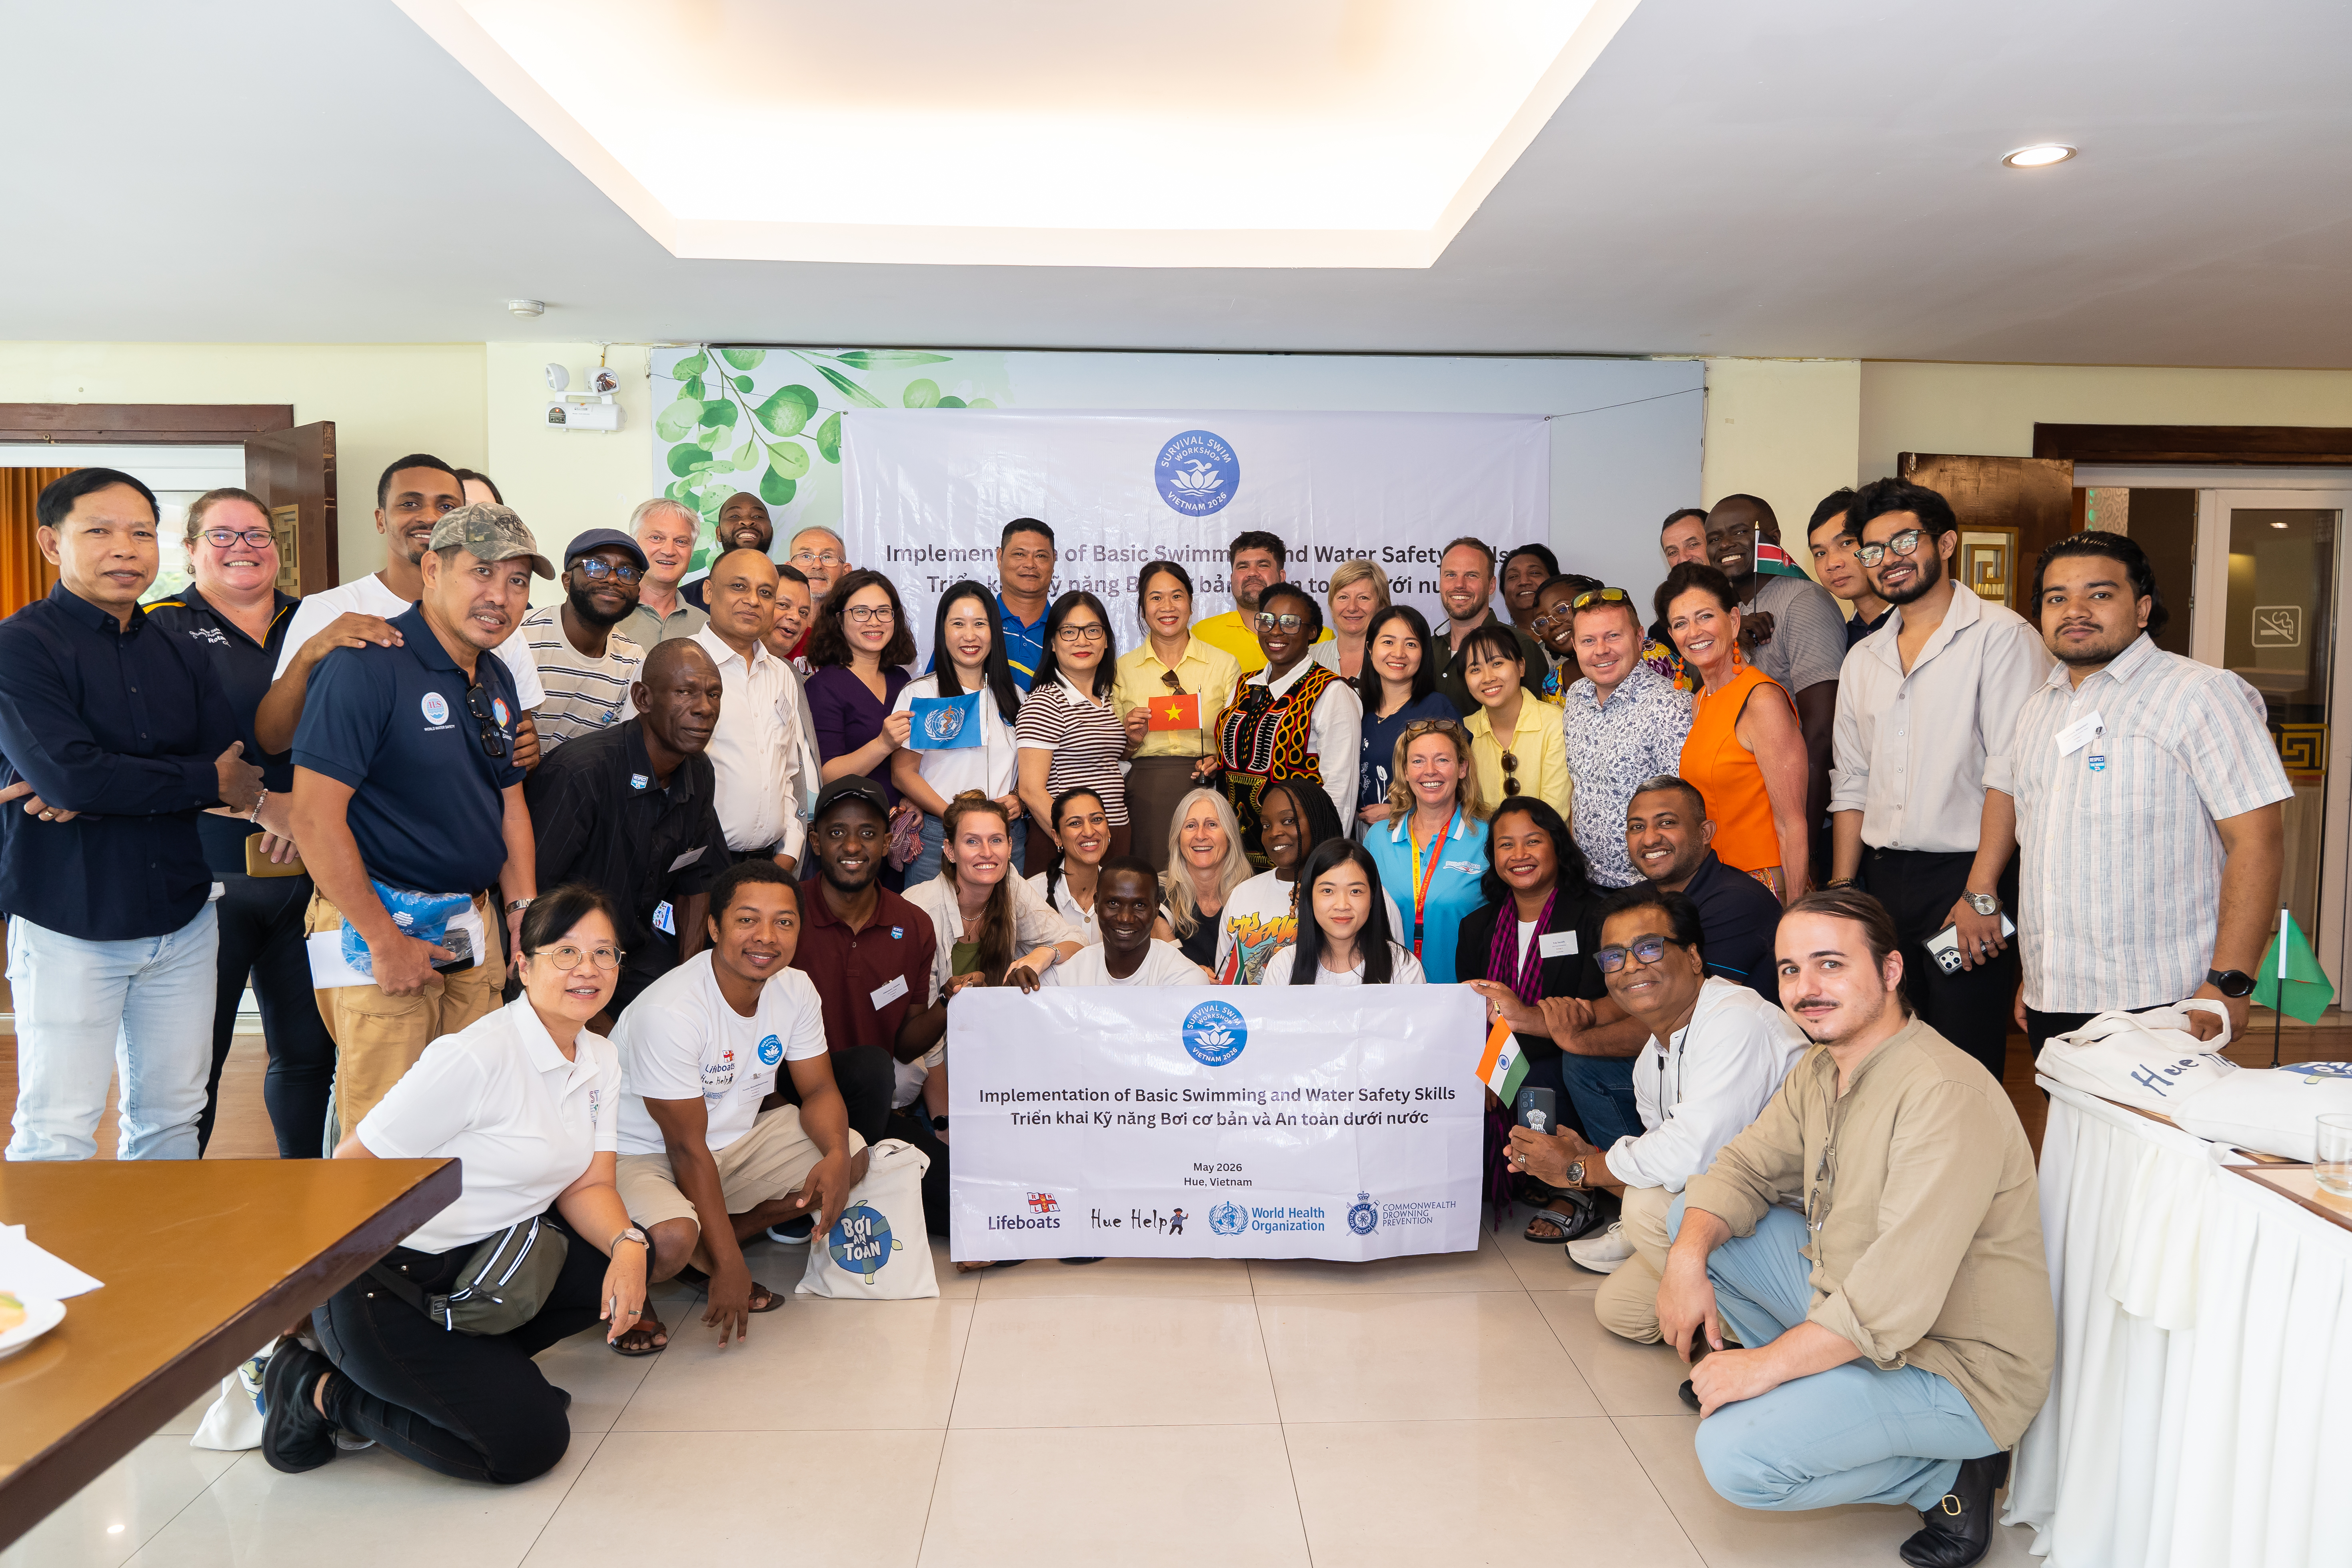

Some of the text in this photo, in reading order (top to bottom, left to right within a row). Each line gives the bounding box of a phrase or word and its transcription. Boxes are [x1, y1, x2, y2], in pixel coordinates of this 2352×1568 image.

[1161, 436, 1232, 467] SURVIVAL SWIM
[1174, 447, 1220, 461] WORKSHOP
[1167, 491, 1227, 511] VIETNAM 2026
[1065, 545, 1087, 562] of
[1093, 544, 1149, 563] Basic
[1154, 544, 1231, 563] Swimm
[1284, 545, 1308, 563] nd
[1314, 545, 1376, 563] Water
[1069, 575, 1120, 597] năng
[1187, 1005, 1241, 1029] SURVIVAL SWIM
[1197, 1013, 1232, 1025] WORKSHOP
[761, 1037, 775, 1048] SURVIVAL
[1192, 1047, 1238, 1062] VIETNAM 2026
[700, 1074, 713, 1085] Hue
[2131, 1059, 2200, 1097] Hue
[979, 1086, 1455, 1105] Implementation of Basic Swimming and Water Safety Skills
[1010, 1109, 1429, 1129] Triển khai Kỹ năng Bơi cơ bản và An toàn dưới nước
[1194, 1163, 1242, 1173] May 2026
[1184, 1177, 1252, 1188] Hue, Vietnam
[1252, 1207, 1325, 1218] World Health
[1383, 1201, 1456, 1211] COMMONWEALTH
[1091, 1208, 1168, 1234] Hue Help
[1383, 1210, 1429, 1219] DROWNING
[1383, 1217, 1433, 1227] PREVENTION
[841, 1215, 872, 1238] BƠI
[989, 1215, 1061, 1230] Lifeboats
[1252, 1220, 1325, 1234] Organization
[853, 1233, 867, 1245] AN
[843, 1241, 881, 1261] TOÀN
